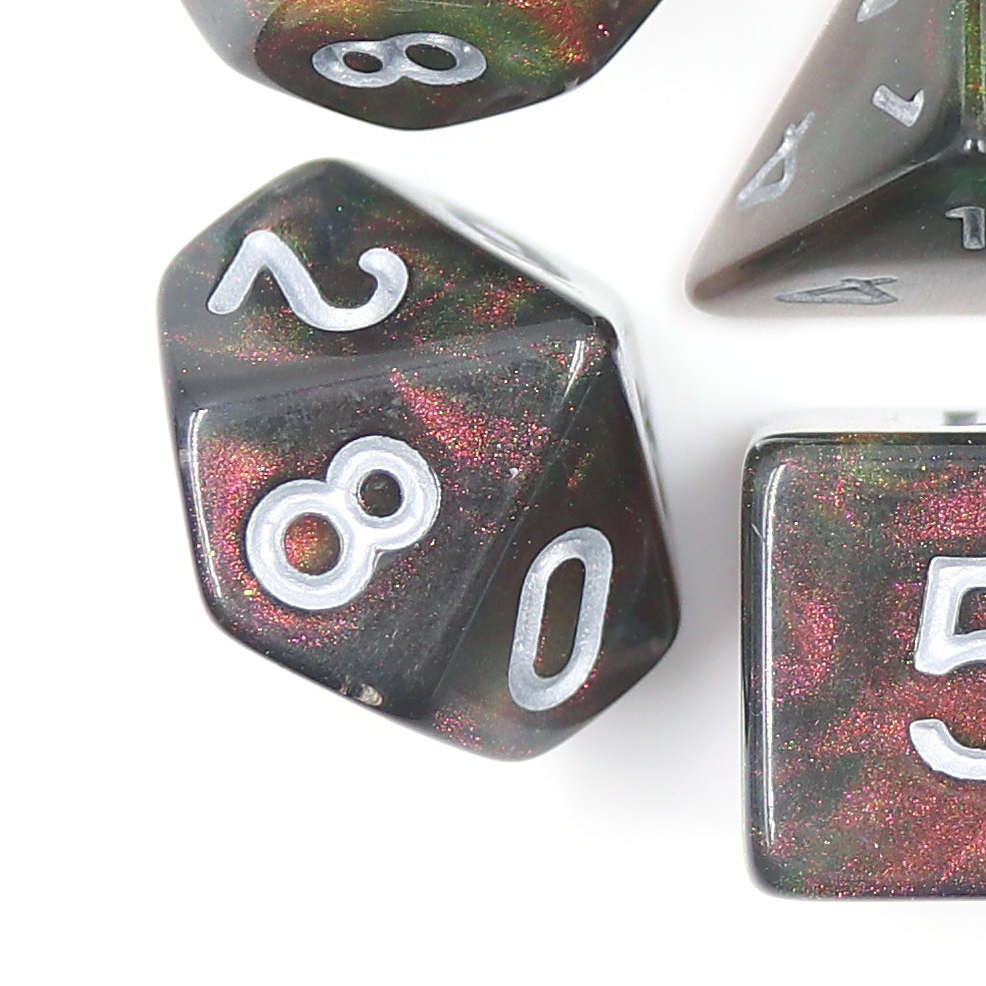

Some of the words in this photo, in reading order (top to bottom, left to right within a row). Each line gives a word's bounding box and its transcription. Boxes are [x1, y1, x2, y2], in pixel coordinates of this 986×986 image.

[311, 31, 487, 88] 8
[872, 84, 924, 127] 1
[735, 112, 814, 209] 4
[945, 205, 986, 251] 1
[207, 229, 409, 332] 2
[775, 276, 898, 304] 4
[245, 434, 442, 611] 8
[507, 526, 614, 713] 0
